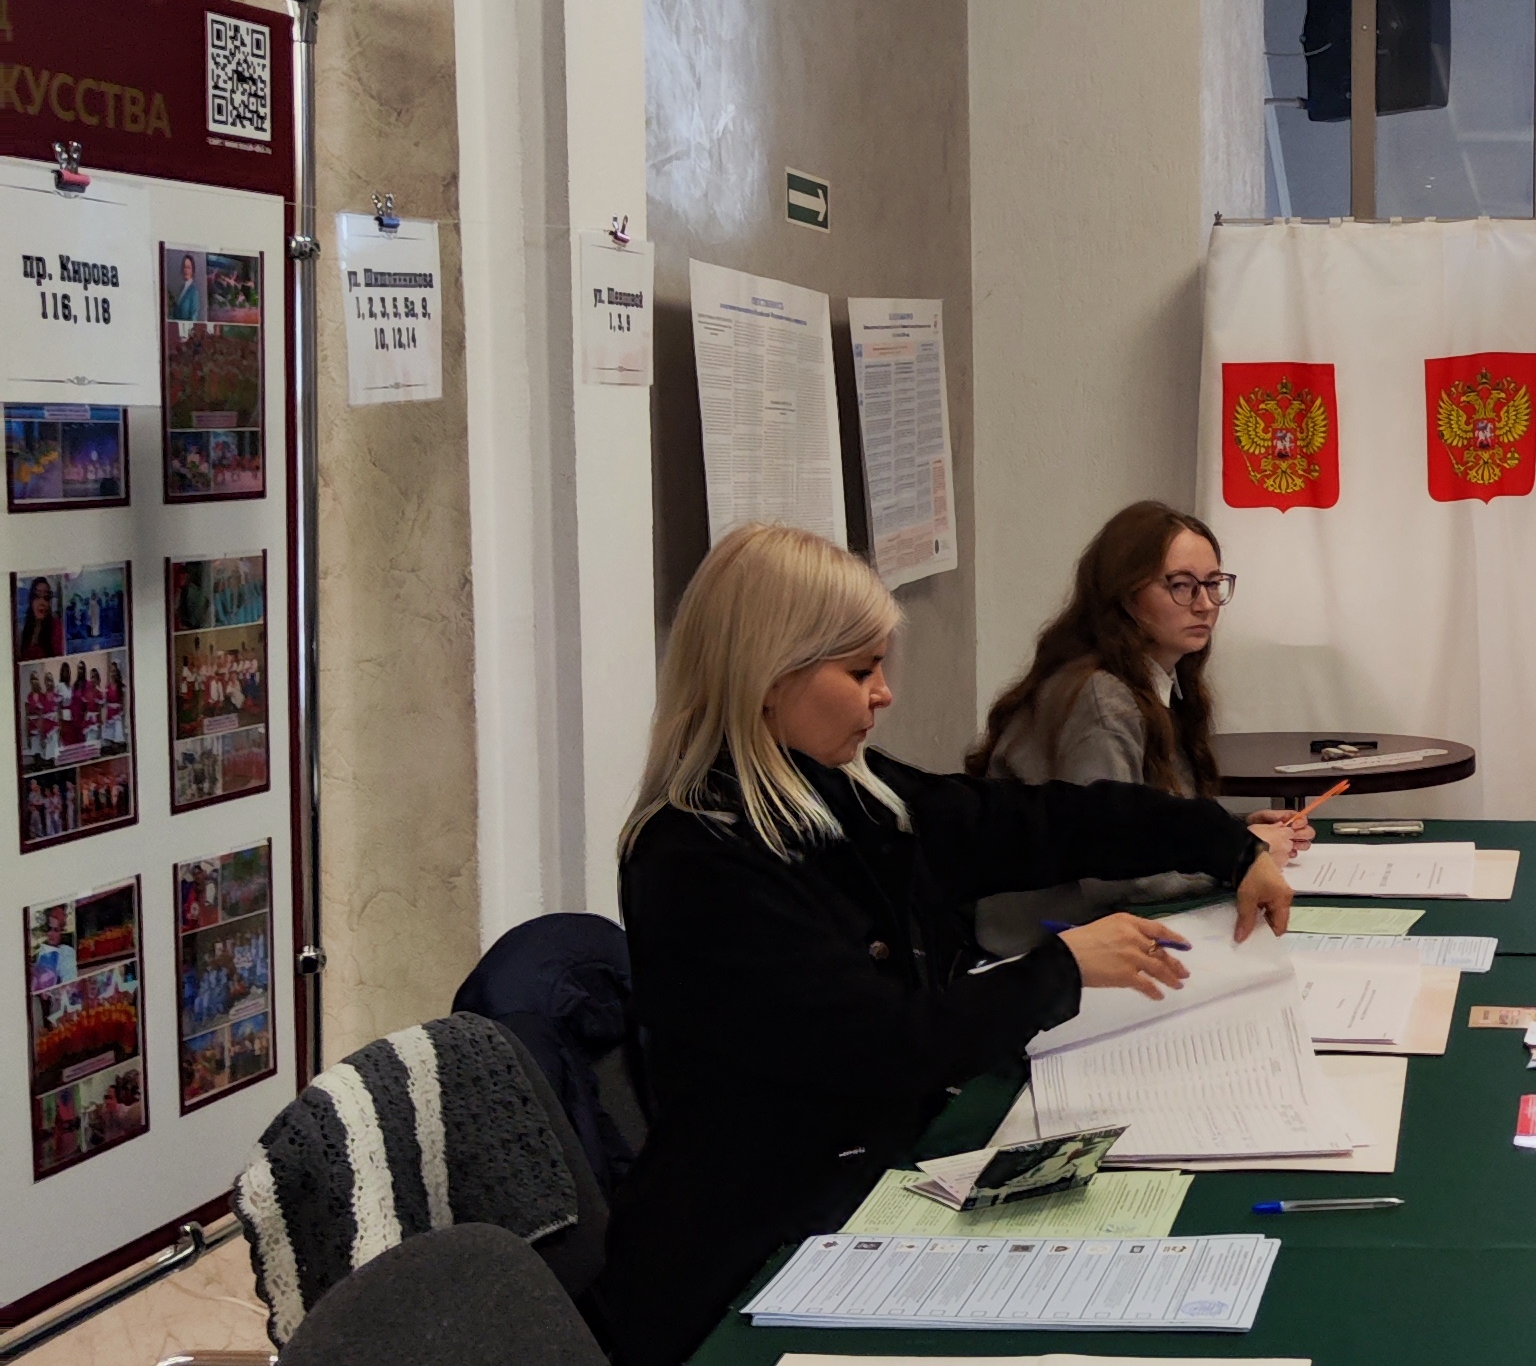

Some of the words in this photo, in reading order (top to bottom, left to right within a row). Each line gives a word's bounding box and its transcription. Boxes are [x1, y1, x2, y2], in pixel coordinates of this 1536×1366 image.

[22, 255, 53, 287] пр.
[59, 253, 120, 291] Кирова
[40, 291, 78, 325] 116,
[84, 295, 111, 325] 118
